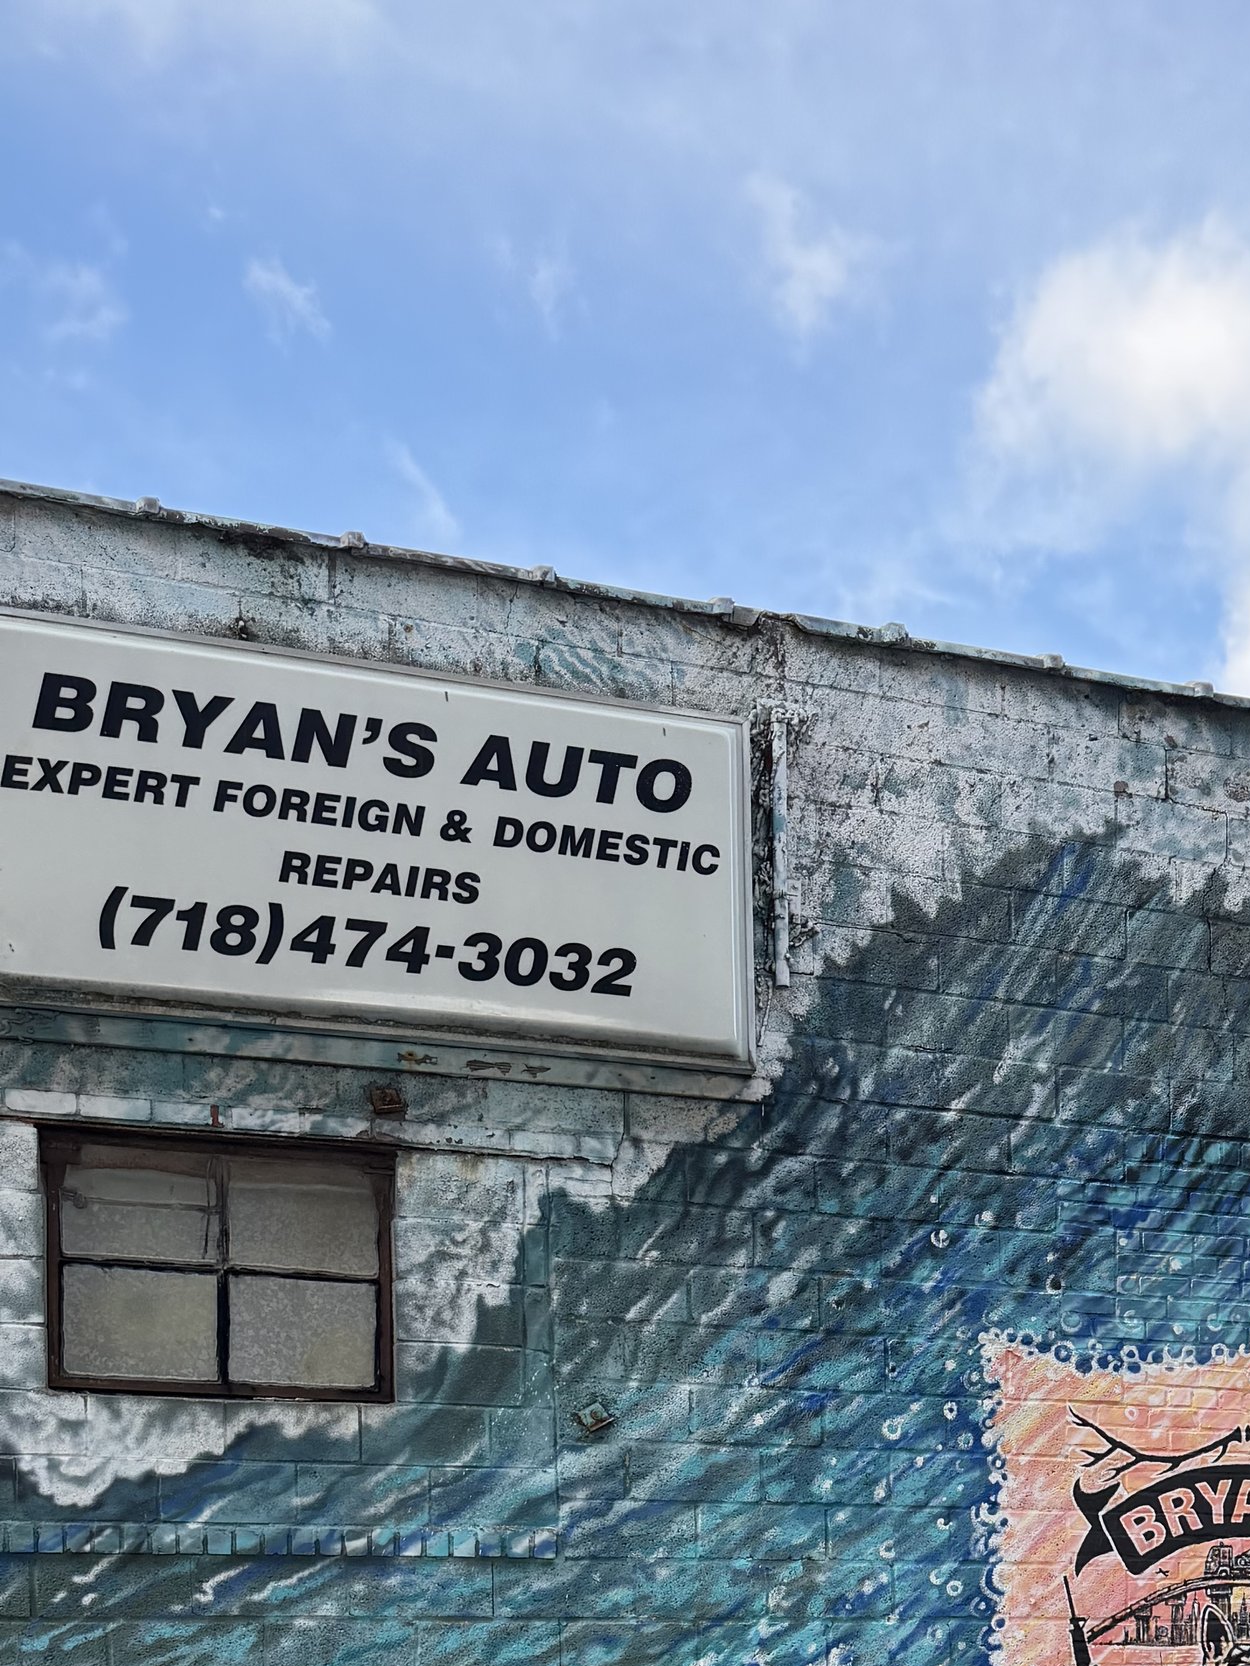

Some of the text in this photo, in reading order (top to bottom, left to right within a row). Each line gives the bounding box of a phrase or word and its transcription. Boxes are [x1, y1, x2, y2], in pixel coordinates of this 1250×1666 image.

[32, 672, 692, 813] BRYAN'S AUTO
[0, 755, 721, 876] EXPERT FOREIGN & DOMESTIC
[279, 851, 481, 904] REPAIRS
[99, 886, 637, 997] (718)474-3032
